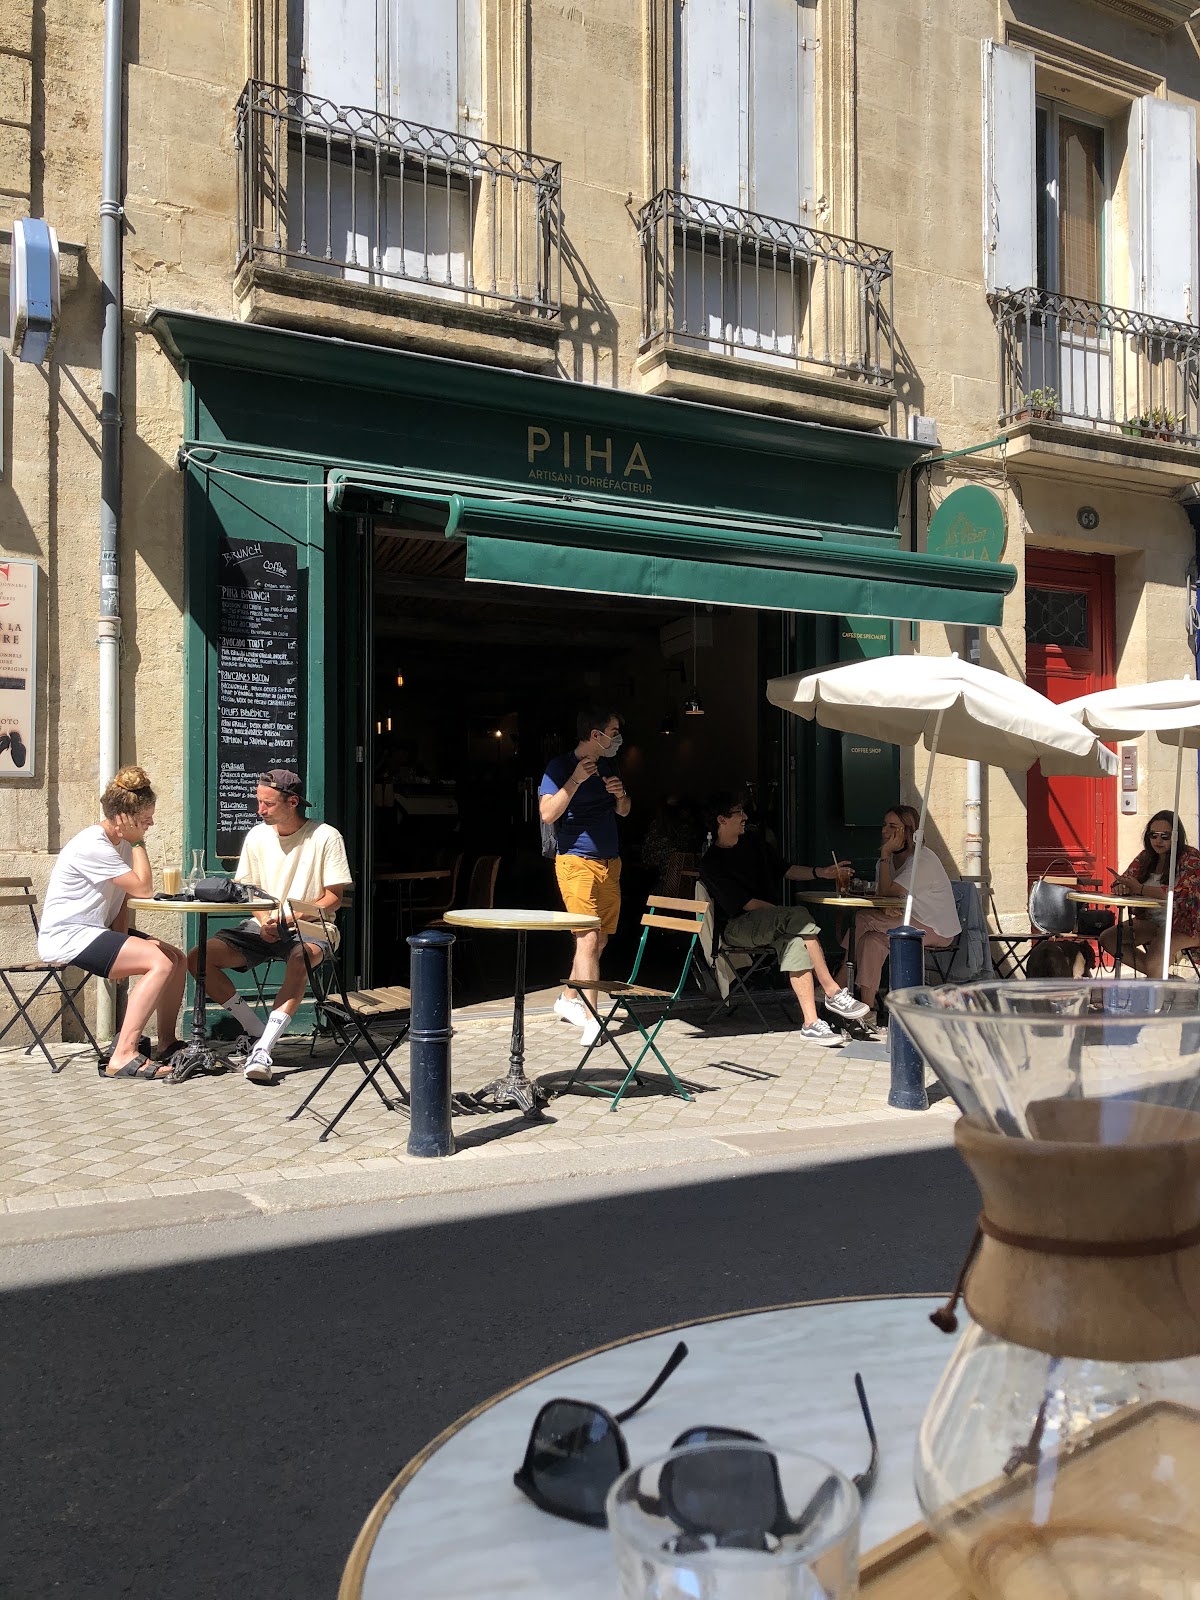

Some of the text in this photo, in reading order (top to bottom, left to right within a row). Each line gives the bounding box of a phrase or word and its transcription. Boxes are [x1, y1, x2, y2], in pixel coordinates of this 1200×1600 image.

[527, 425, 653, 480] PIHA
[528, 469, 653, 494] ARTISAN TORRÉFACTEUR
[1082, 512, 1095, 526] 69
[221, 543, 263, 567] BRUNCH
